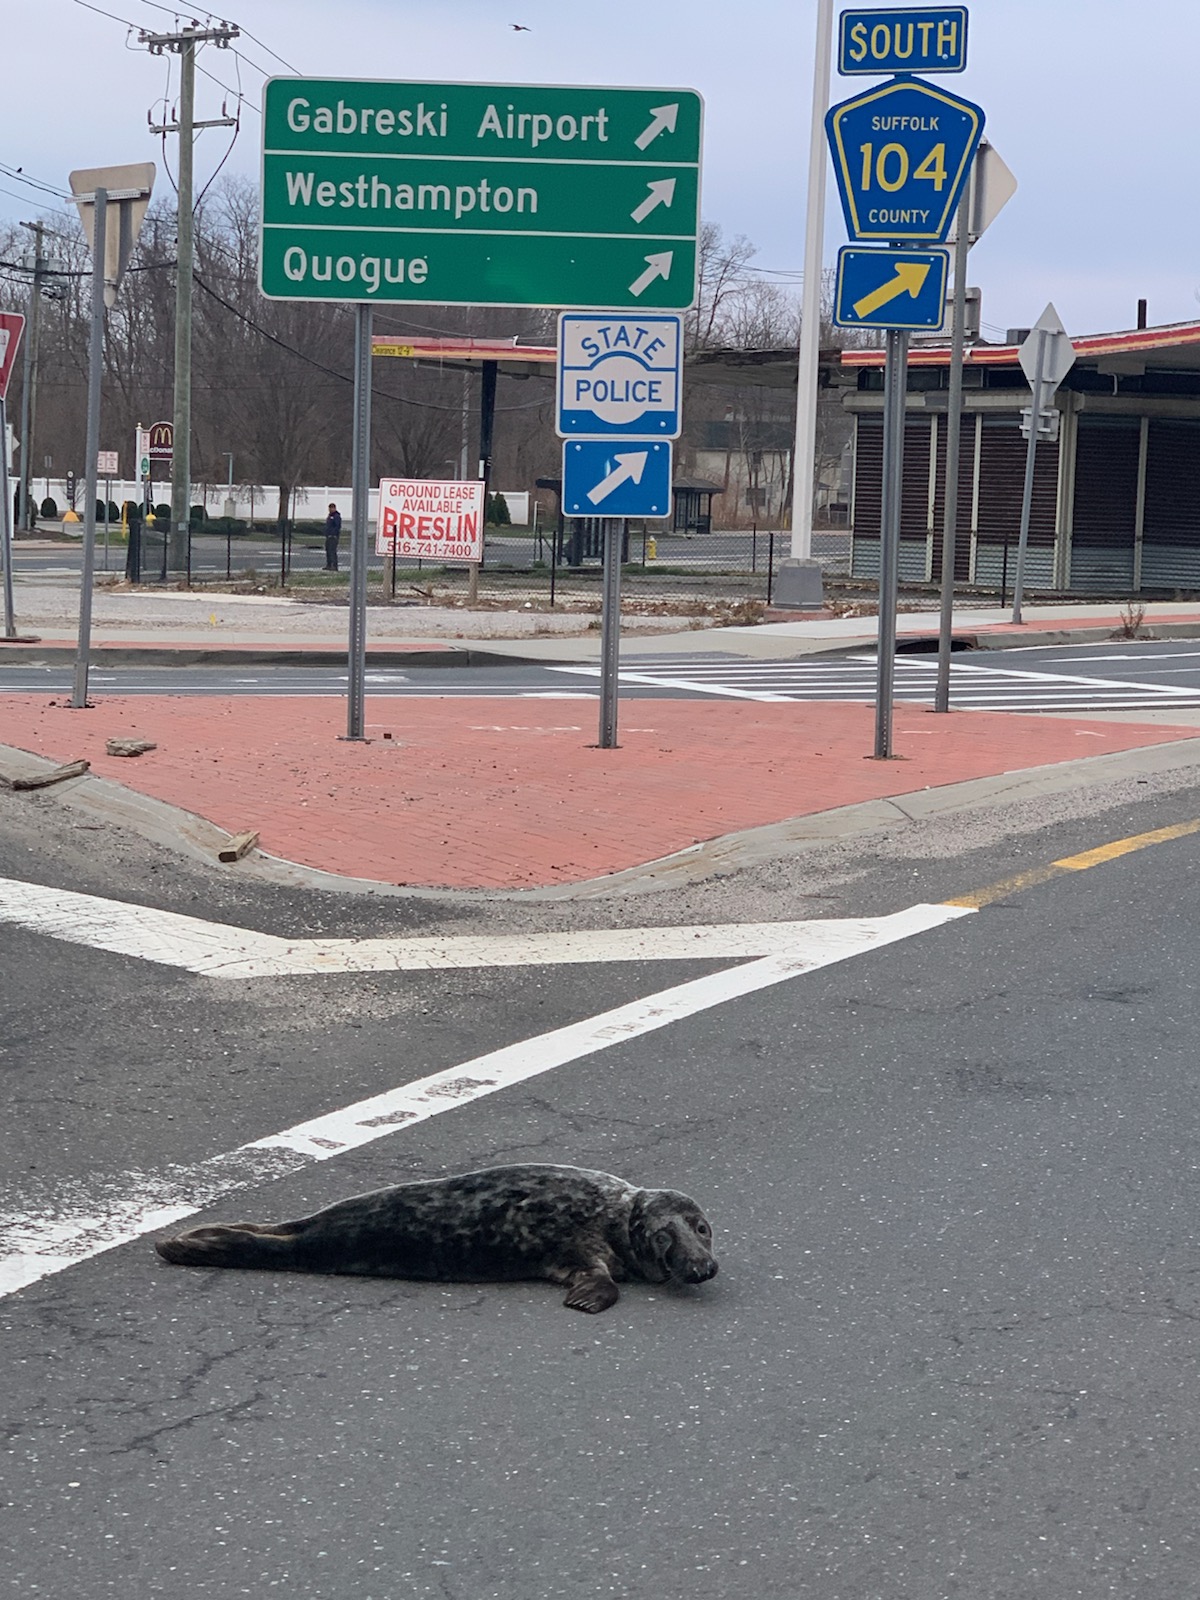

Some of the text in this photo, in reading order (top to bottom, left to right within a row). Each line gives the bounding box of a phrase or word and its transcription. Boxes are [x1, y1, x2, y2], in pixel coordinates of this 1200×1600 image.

[849, 21, 957, 60] SOUTH
[286, 97, 609, 148] Gabreski Airport
[871, 115, 940, 132] SUFFOLK
[859, 142, 948, 192] 104
[285, 171, 538, 220] Westhampton
[868, 208, 930, 224] COUNTY
[283, 245, 429, 294] Quogue
[580, 325, 666, 361] STATE
[576, 379, 662, 403] POLICE
[389, 484, 475, 500] GROUND LEASE
[402, 499, 462, 513] AVAILABLE
[382, 506, 477, 543] BRESLIN
[387, 541, 472, 557] 516-741-7400
